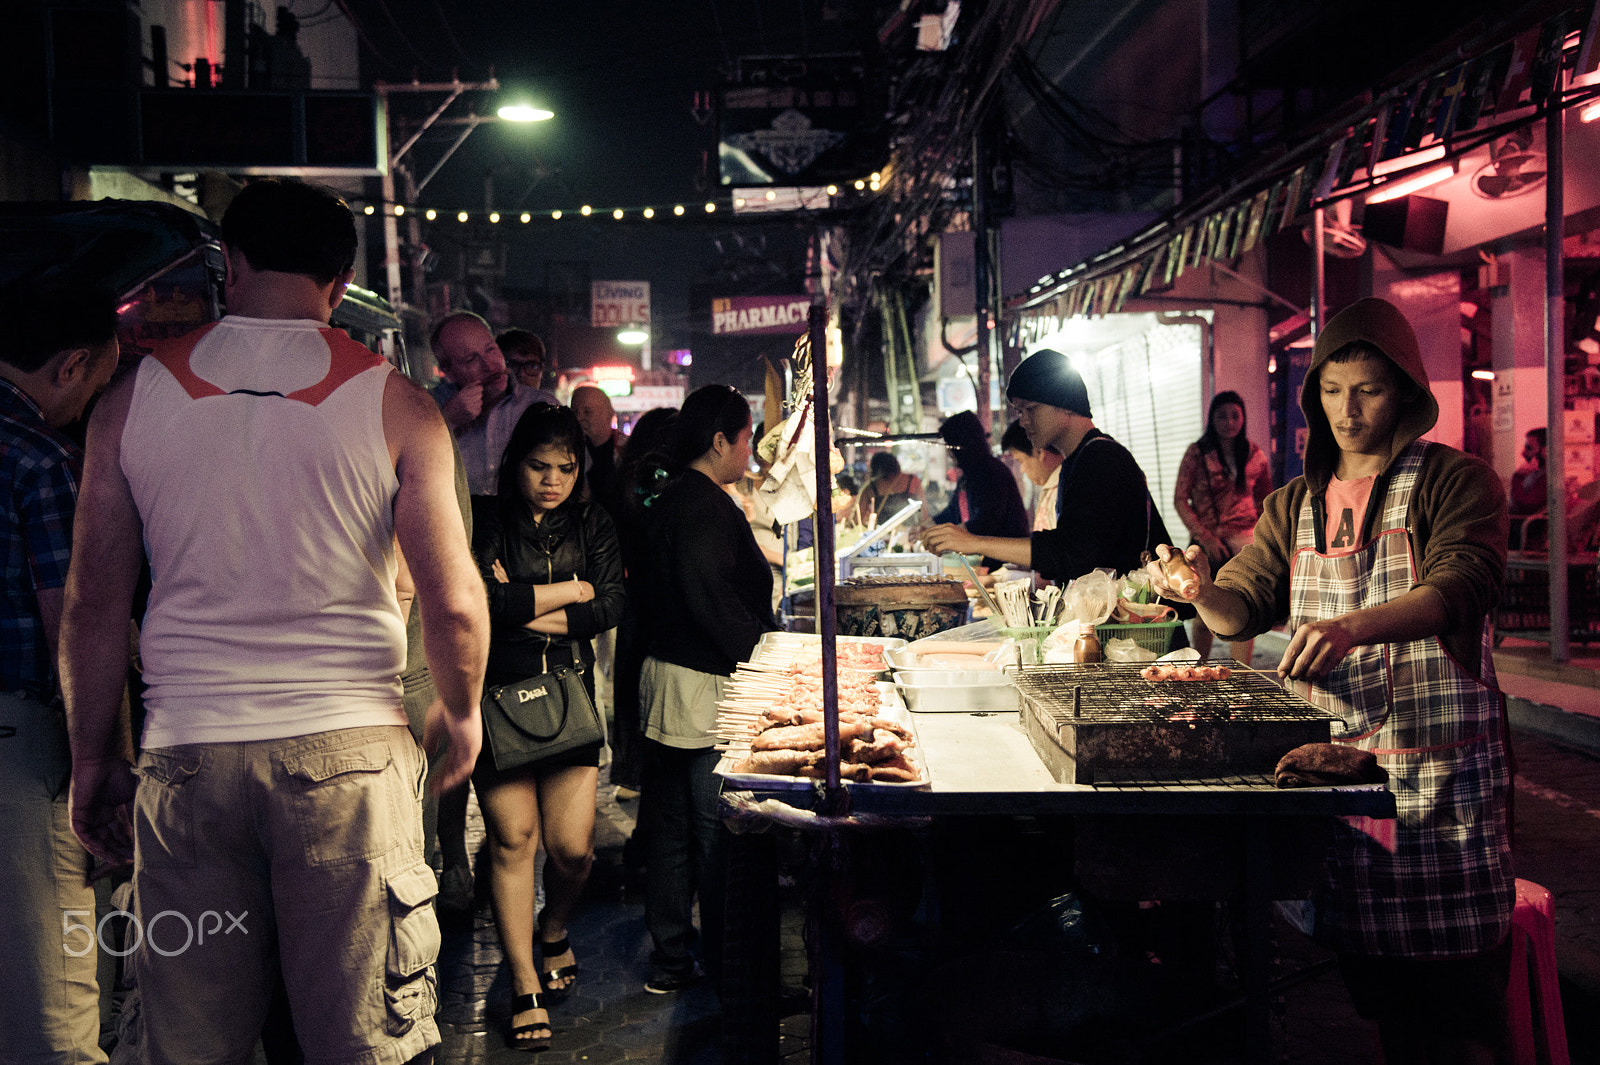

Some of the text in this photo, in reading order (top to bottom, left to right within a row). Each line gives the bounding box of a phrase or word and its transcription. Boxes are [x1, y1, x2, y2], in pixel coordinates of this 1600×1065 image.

[596, 286, 644, 299] LIVING
[713, 300, 812, 334] PHARMACY
[1331, 508, 1355, 548] A
